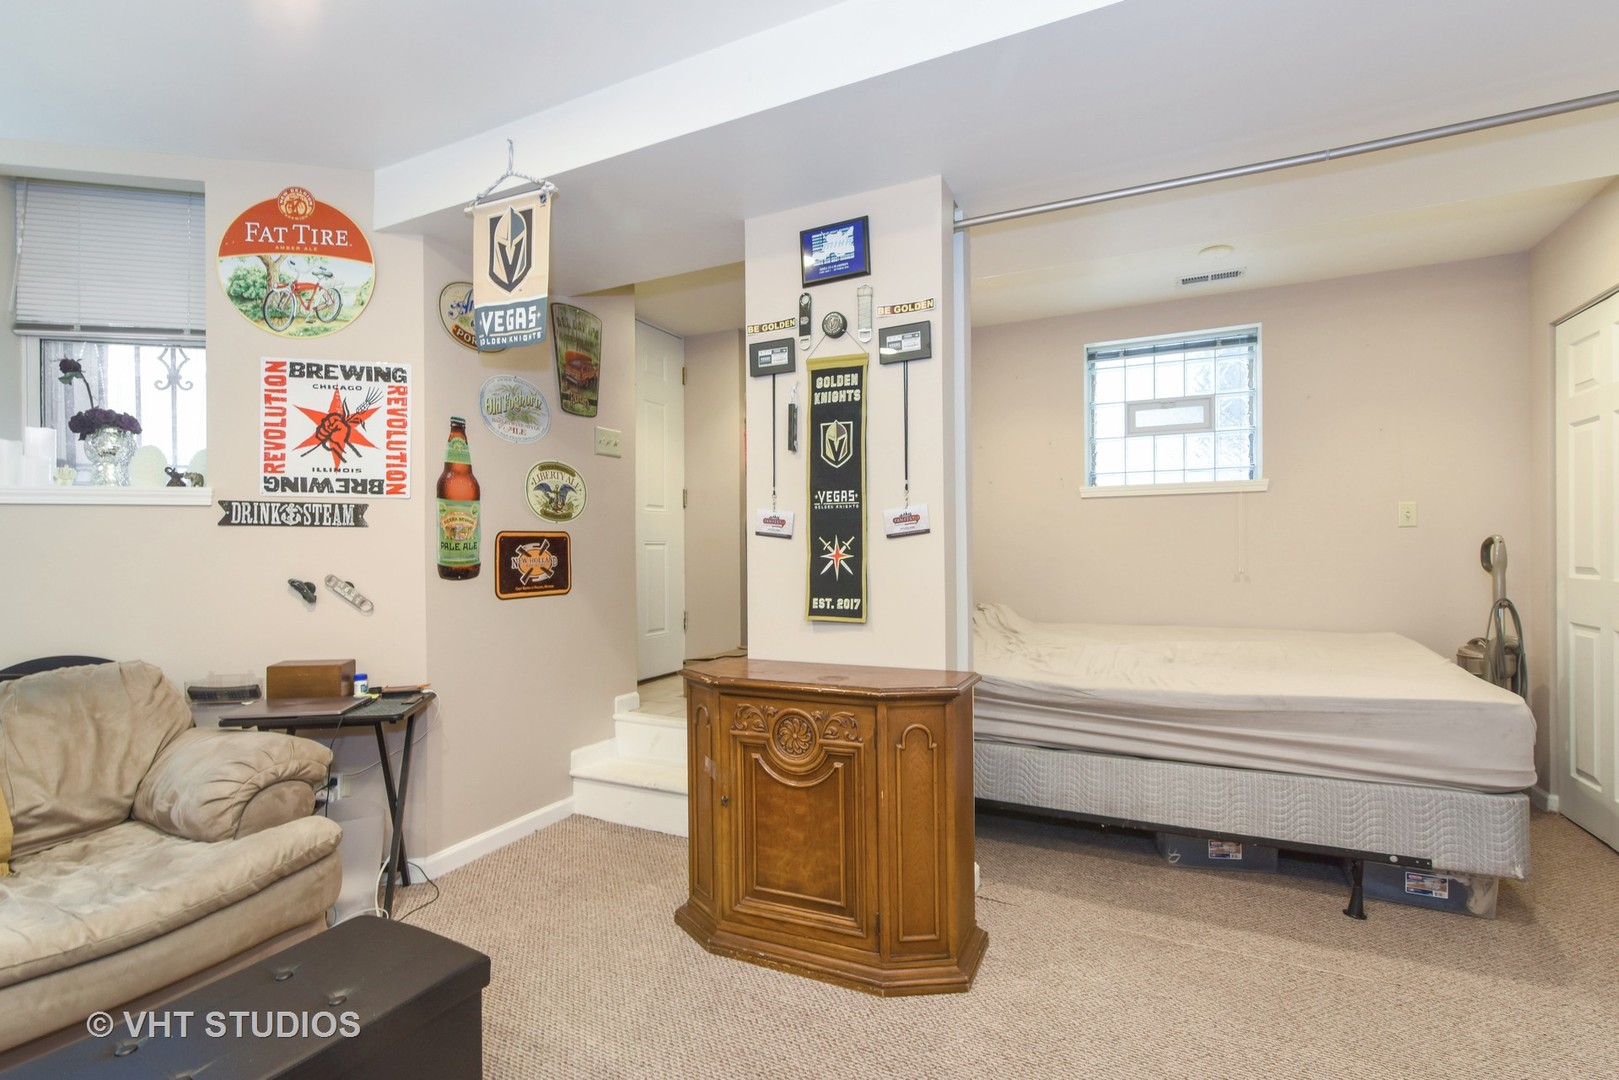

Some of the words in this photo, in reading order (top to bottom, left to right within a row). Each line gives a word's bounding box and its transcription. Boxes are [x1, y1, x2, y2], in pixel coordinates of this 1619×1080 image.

[245, 222, 288, 244] FAT
[292, 224, 348, 247] TIRE
[877, 306, 891, 315] BE
[893, 299, 934, 314] GOLDEN
[481, 305, 537, 336] VEGAS
[747, 325, 760, 334] BE
[761, 318, 796, 333] GOLDEN
[509, 331, 542, 343] KNIGHTS
[288, 362, 408, 383] BREWING
[815, 373, 859, 389] GOLDEN
[814, 389, 861, 405] KNIGHTS
[263, 361, 287, 474] REVOLUTION
[385, 385, 408, 495] REVOLUTION
[263, 476, 385, 495] BREWING
[817, 490, 855, 505] VEGAS
[230, 501, 282, 525] DRINK
[303, 503, 355, 526] STEAM
[441, 541, 461, 551] PALE
[463, 541, 478, 550] ALE
[812, 598, 835, 610] EST.
[836, 599, 861, 610] 2017
